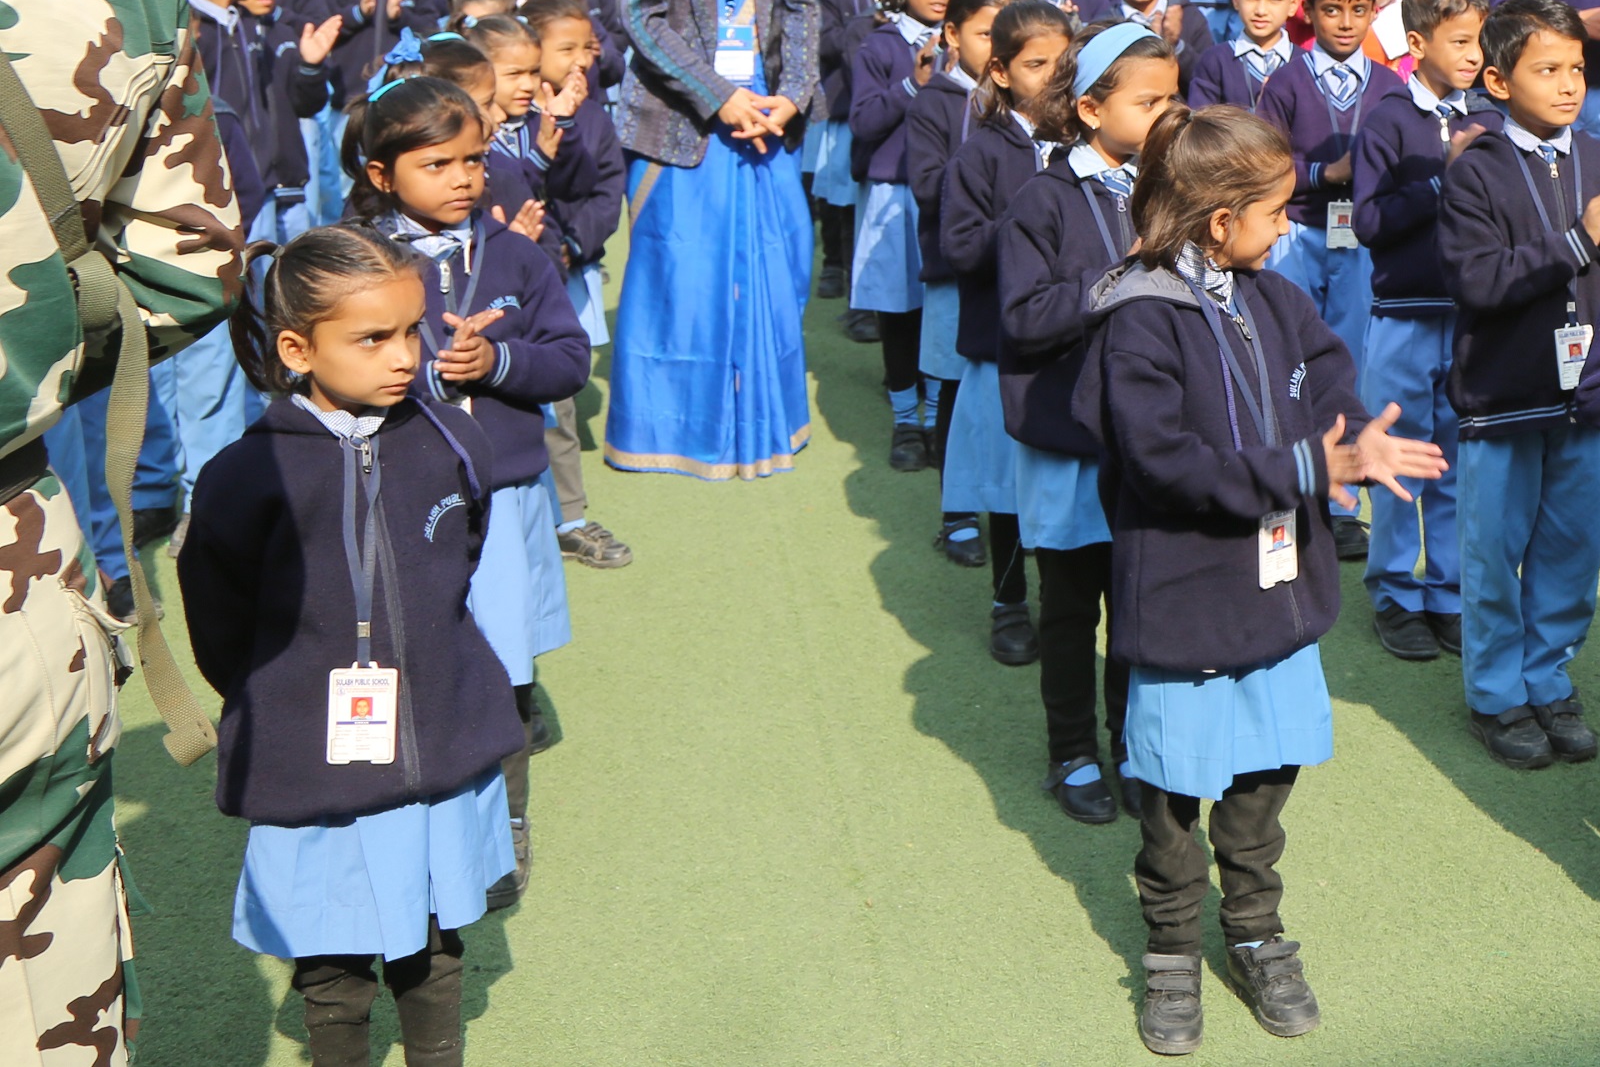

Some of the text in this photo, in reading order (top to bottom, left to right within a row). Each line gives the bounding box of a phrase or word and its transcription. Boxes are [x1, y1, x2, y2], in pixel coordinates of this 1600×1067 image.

[440, 493, 464, 508] PUBL
[336, 678, 390, 686] SULABH PUBLIC SCHOOL
